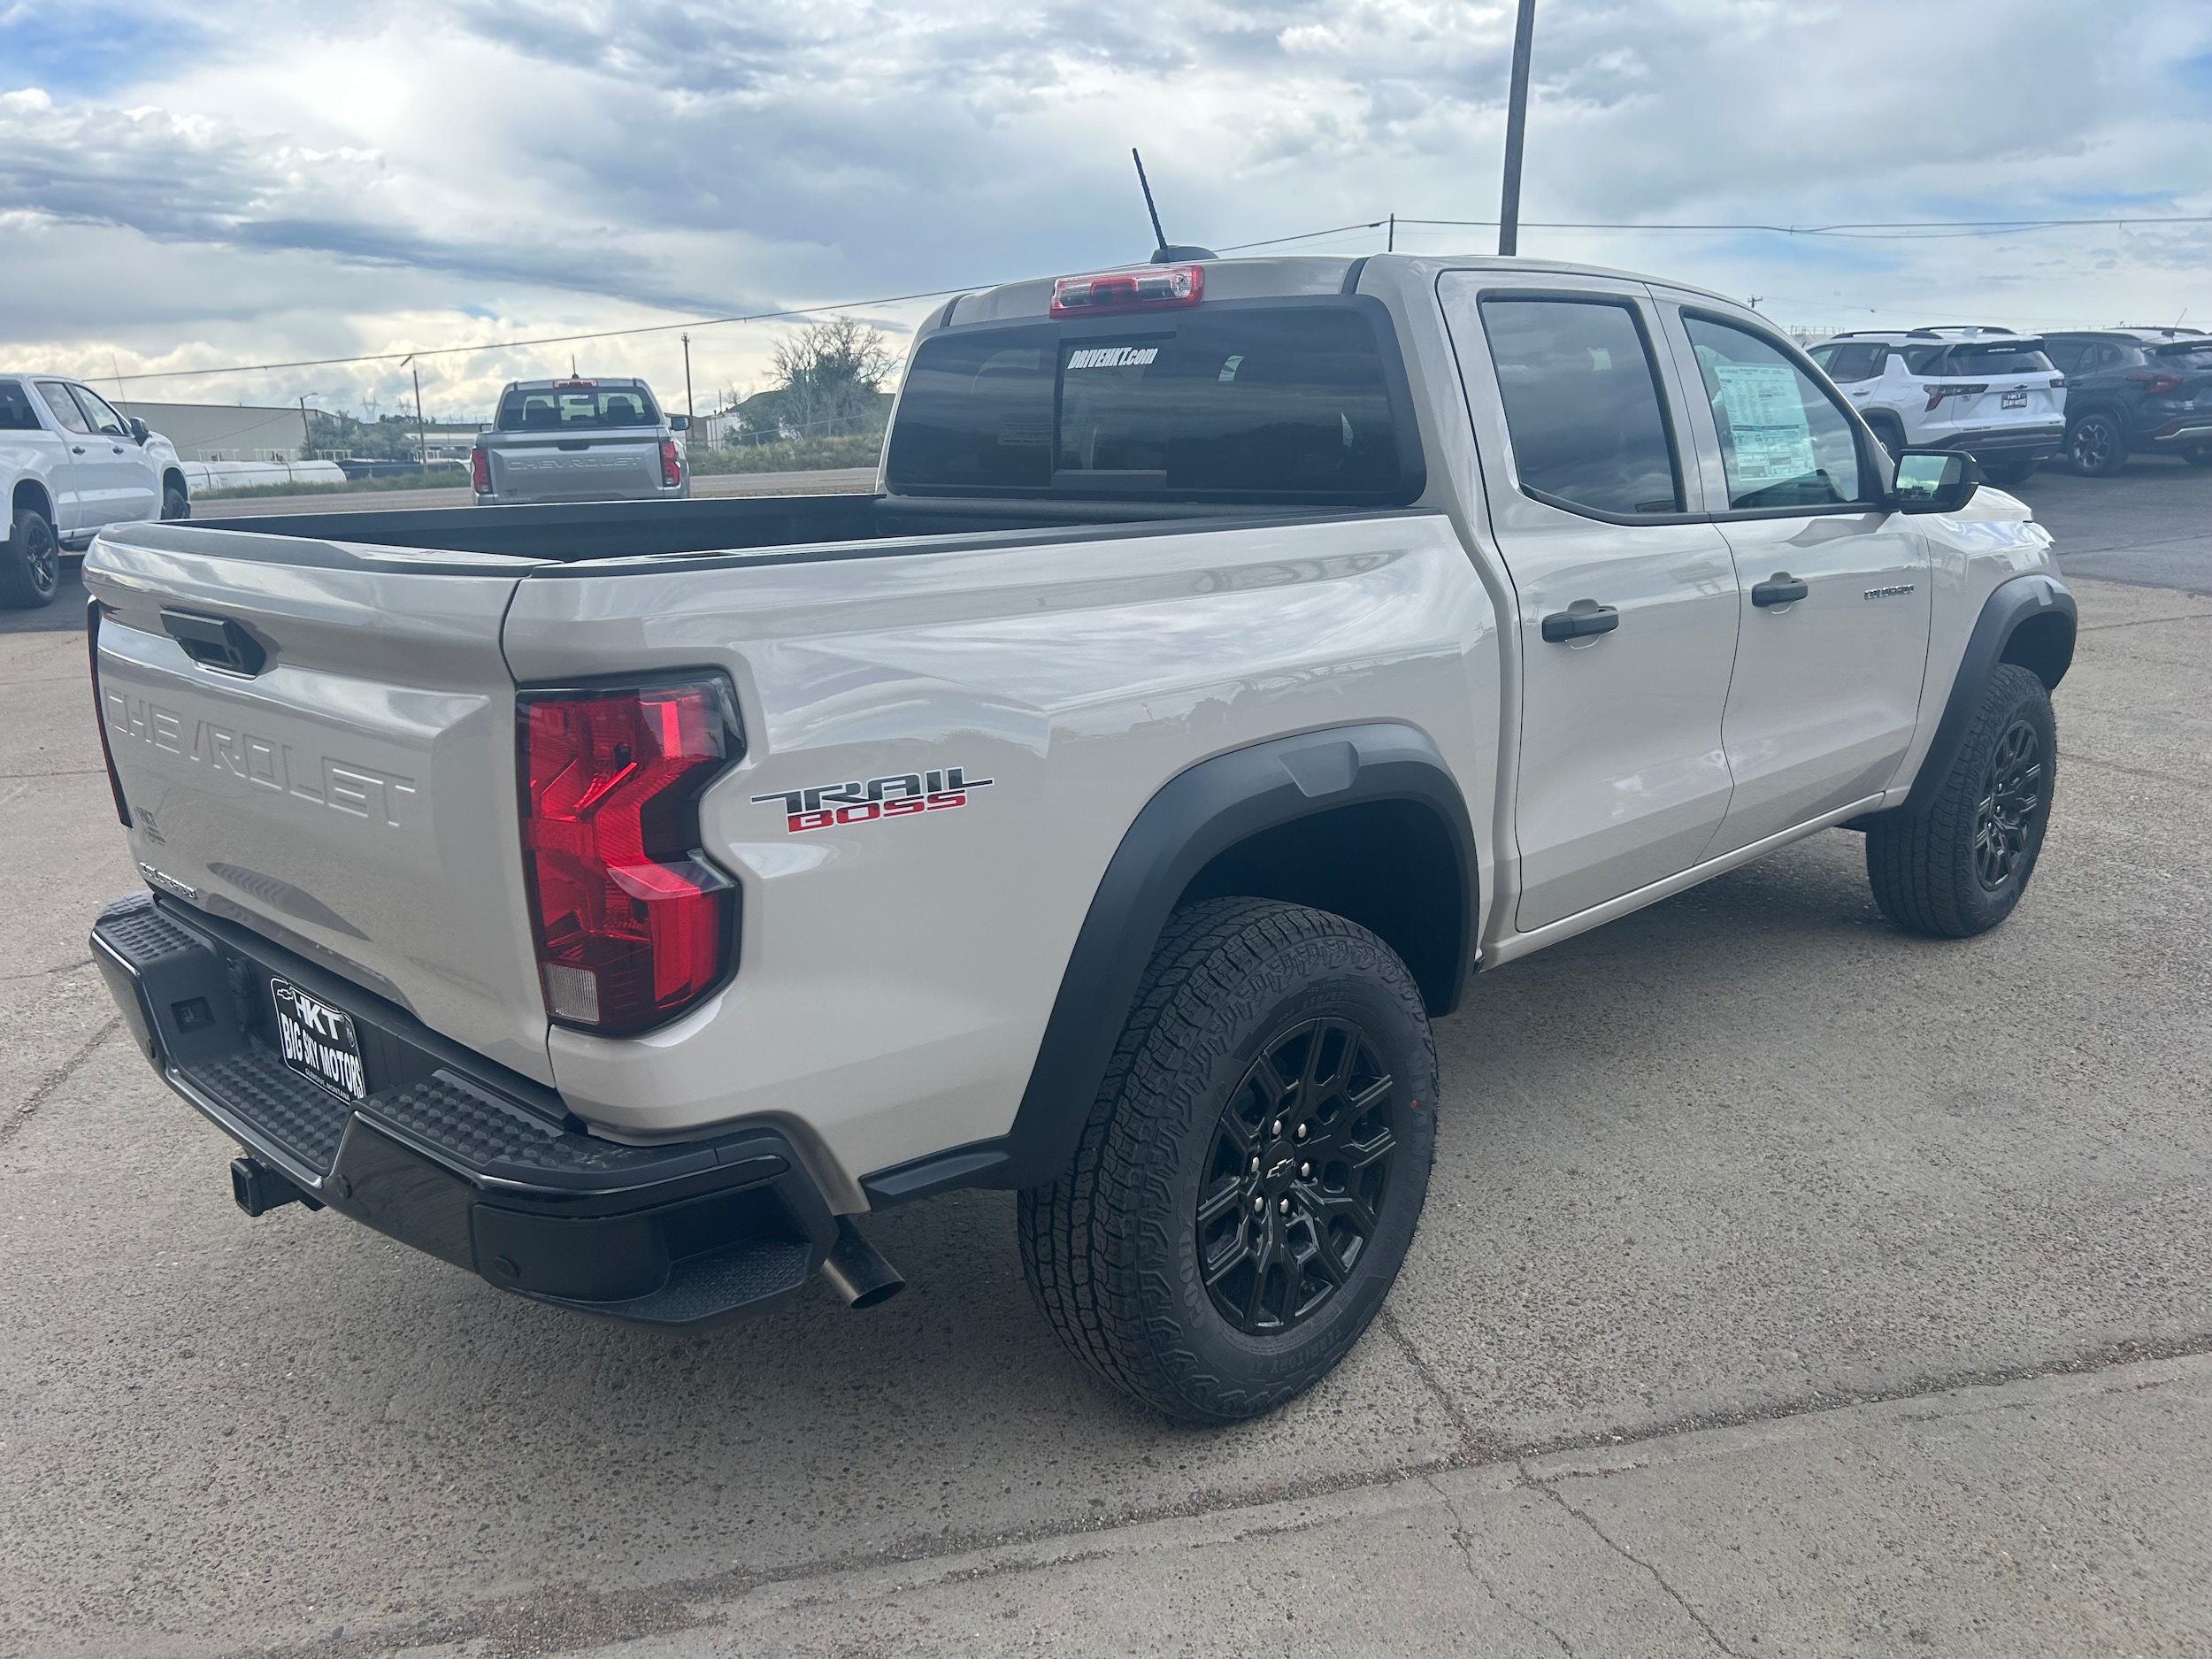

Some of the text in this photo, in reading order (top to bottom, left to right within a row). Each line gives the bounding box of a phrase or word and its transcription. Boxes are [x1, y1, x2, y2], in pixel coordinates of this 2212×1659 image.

[1067, 346, 1159, 369] DRIVEHKT.com
[508, 457, 642, 471] CHEVROLET
[104, 687, 416, 828] CHEVROLET
[750, 766, 995, 816] TRAIL
[787, 788, 967, 834] BOSS
[293, 990, 343, 1041] HKT
[280, 1012, 303, 1062] BIG
[302, 1029, 320, 1071] SKY
[319, 1043, 365, 1100] MOTORS
